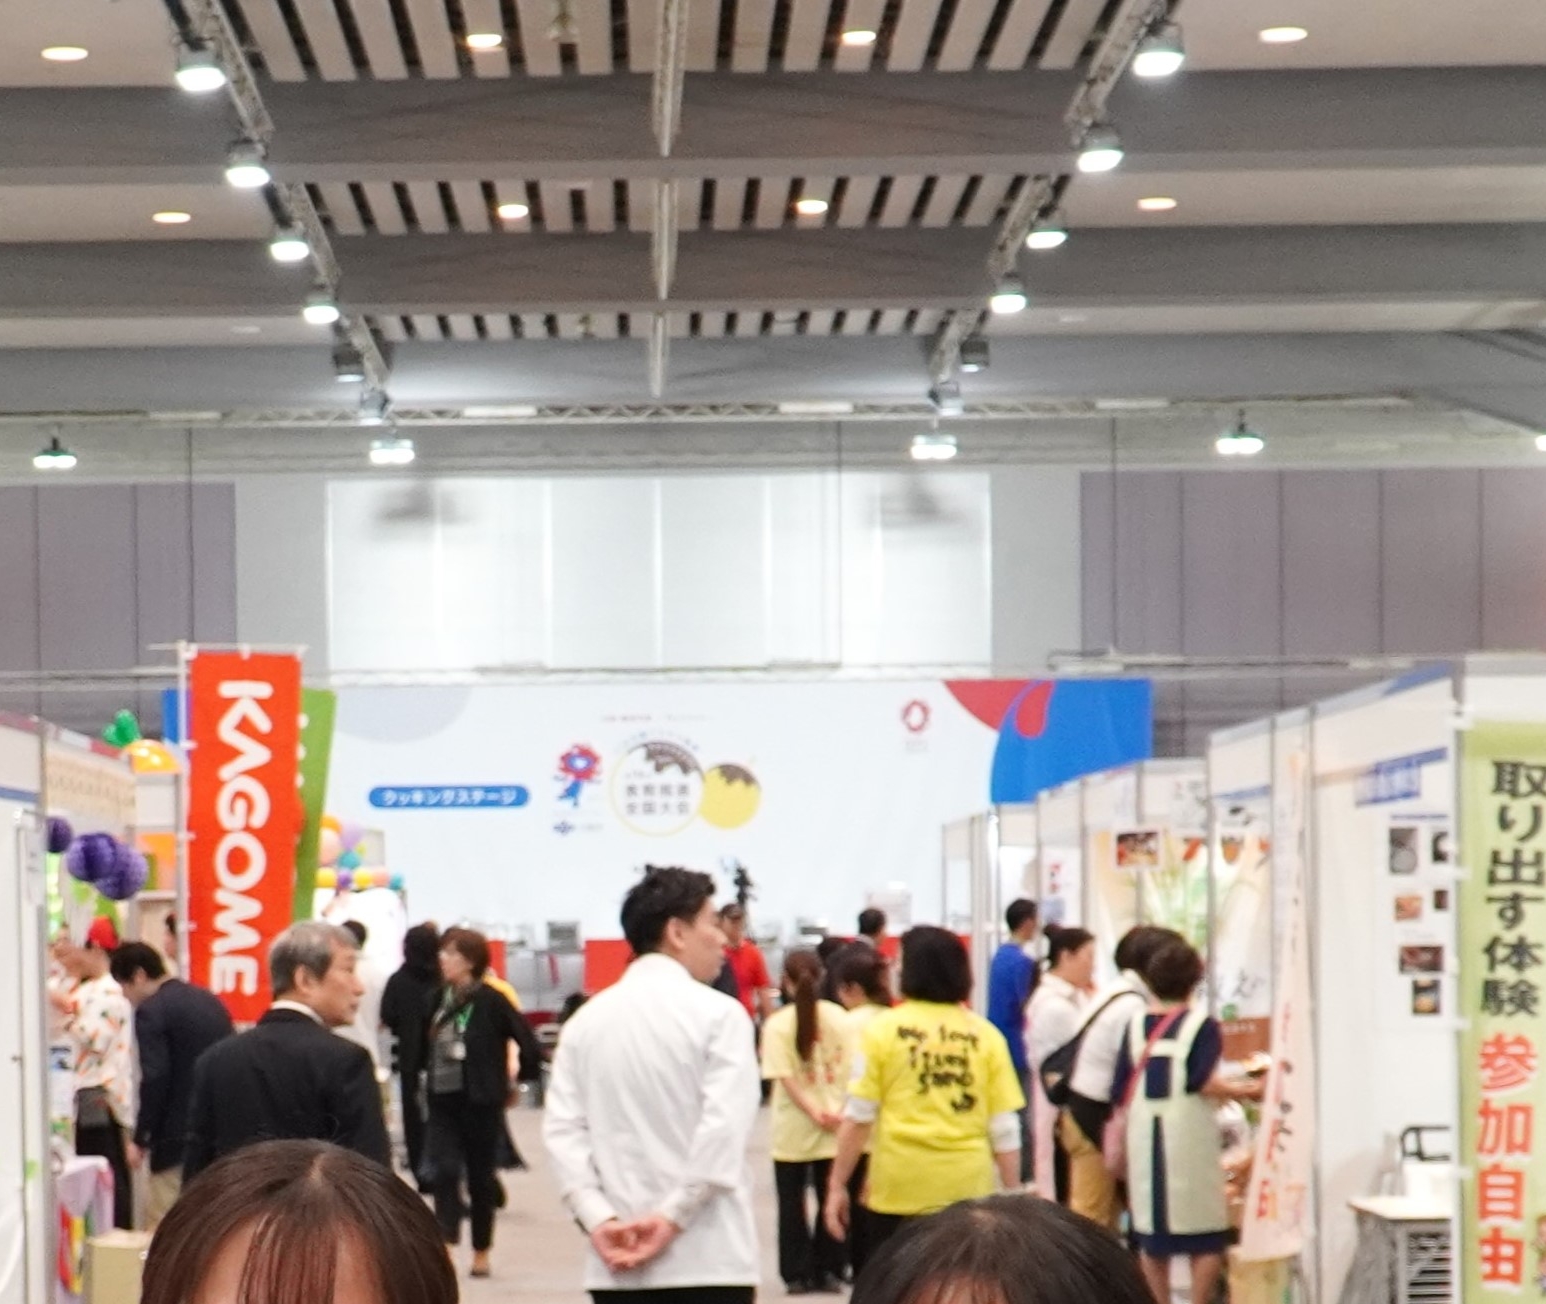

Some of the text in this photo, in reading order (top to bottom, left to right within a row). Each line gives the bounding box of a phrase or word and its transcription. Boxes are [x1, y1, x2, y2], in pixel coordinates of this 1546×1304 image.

[209, 680, 274, 996] KAGOME
[382, 788, 518, 806] クッキングステージ
[1476, 1032, 1539, 1290] 参加自由
